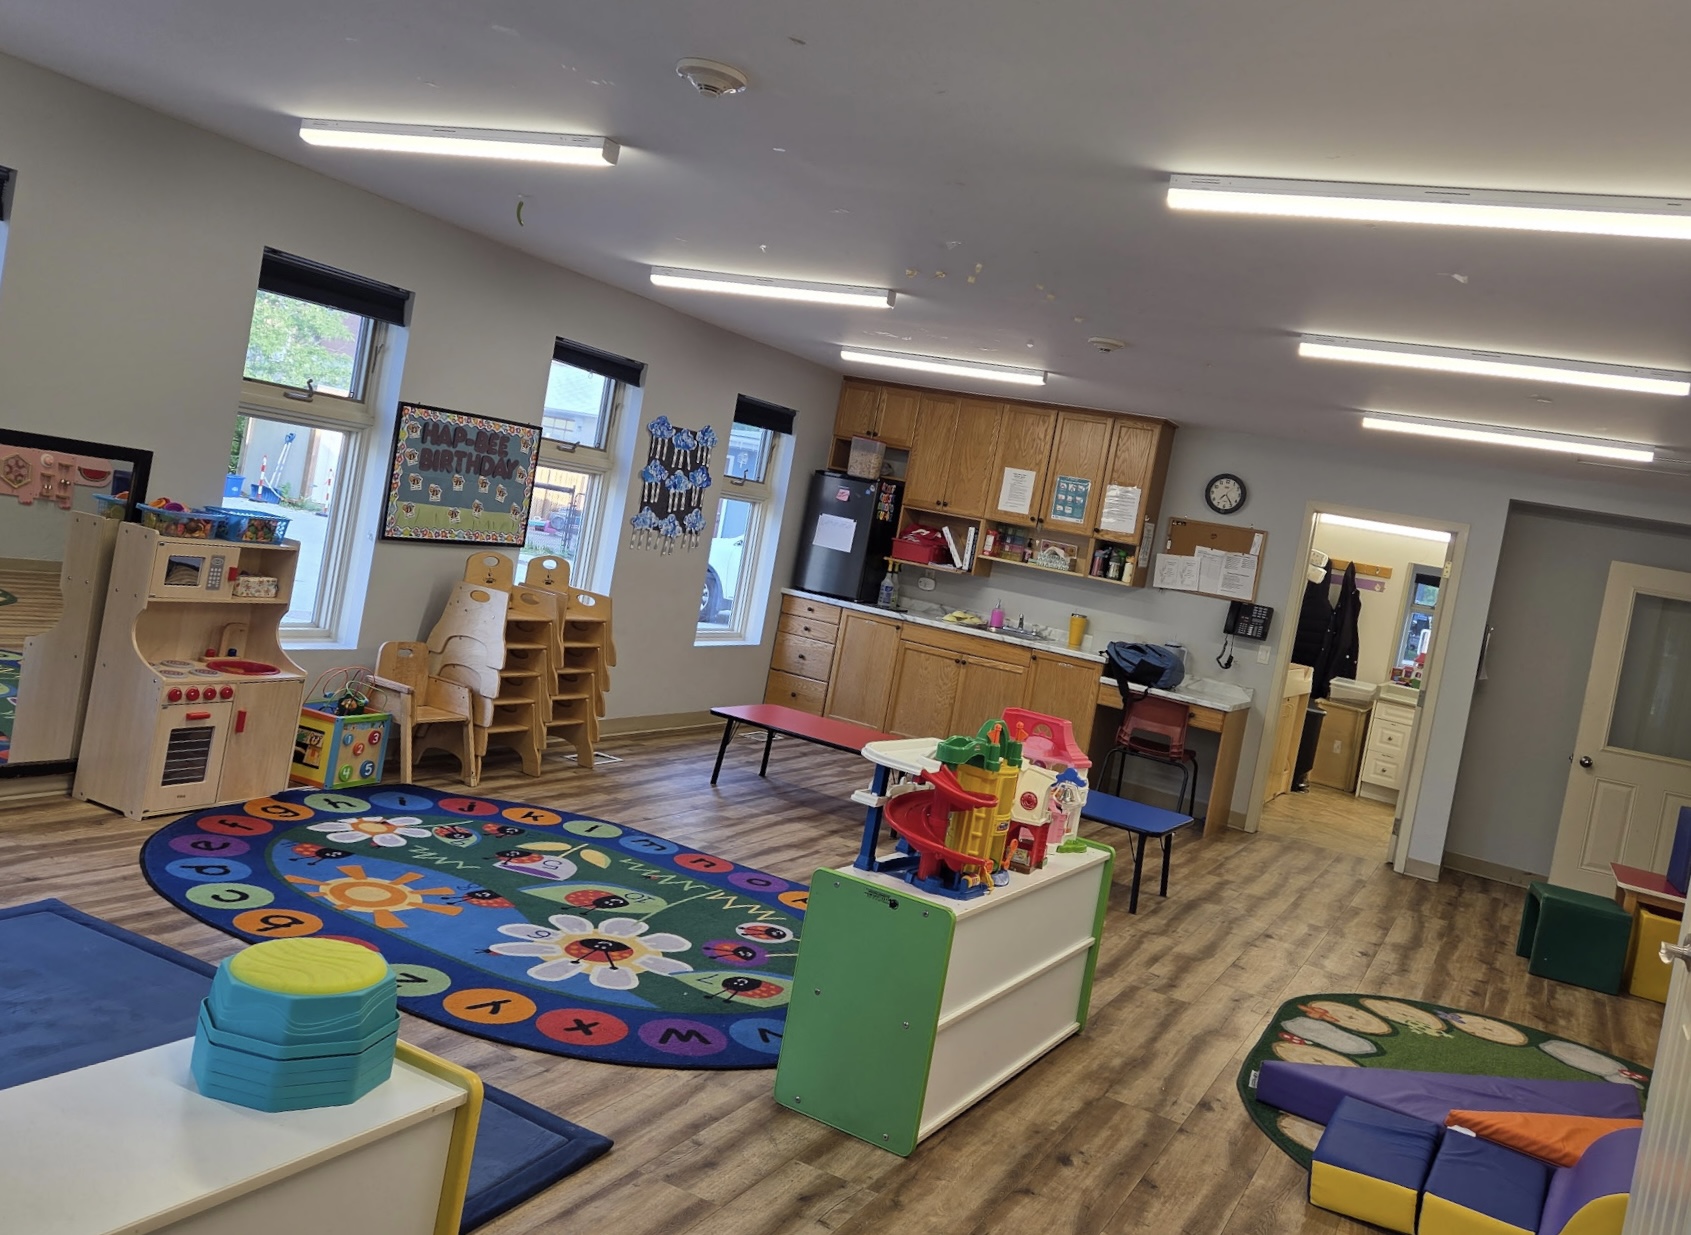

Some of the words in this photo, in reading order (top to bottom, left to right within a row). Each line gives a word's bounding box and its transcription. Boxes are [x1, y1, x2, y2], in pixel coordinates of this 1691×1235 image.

[421, 422, 510, 458] HAP-BEE
[419, 447, 519, 480] BIRTHDAY
[373, 733, 380, 743] 3
[357, 745, 363, 754] 2
[342, 768, 351, 778] 4
[365, 763, 373, 776] 5
[260, 805, 300, 818] g
[218, 819, 254, 831] f
[190, 840, 231, 851] e
[542, 860, 562, 870] 5
[563, 1018, 600, 1036] x
